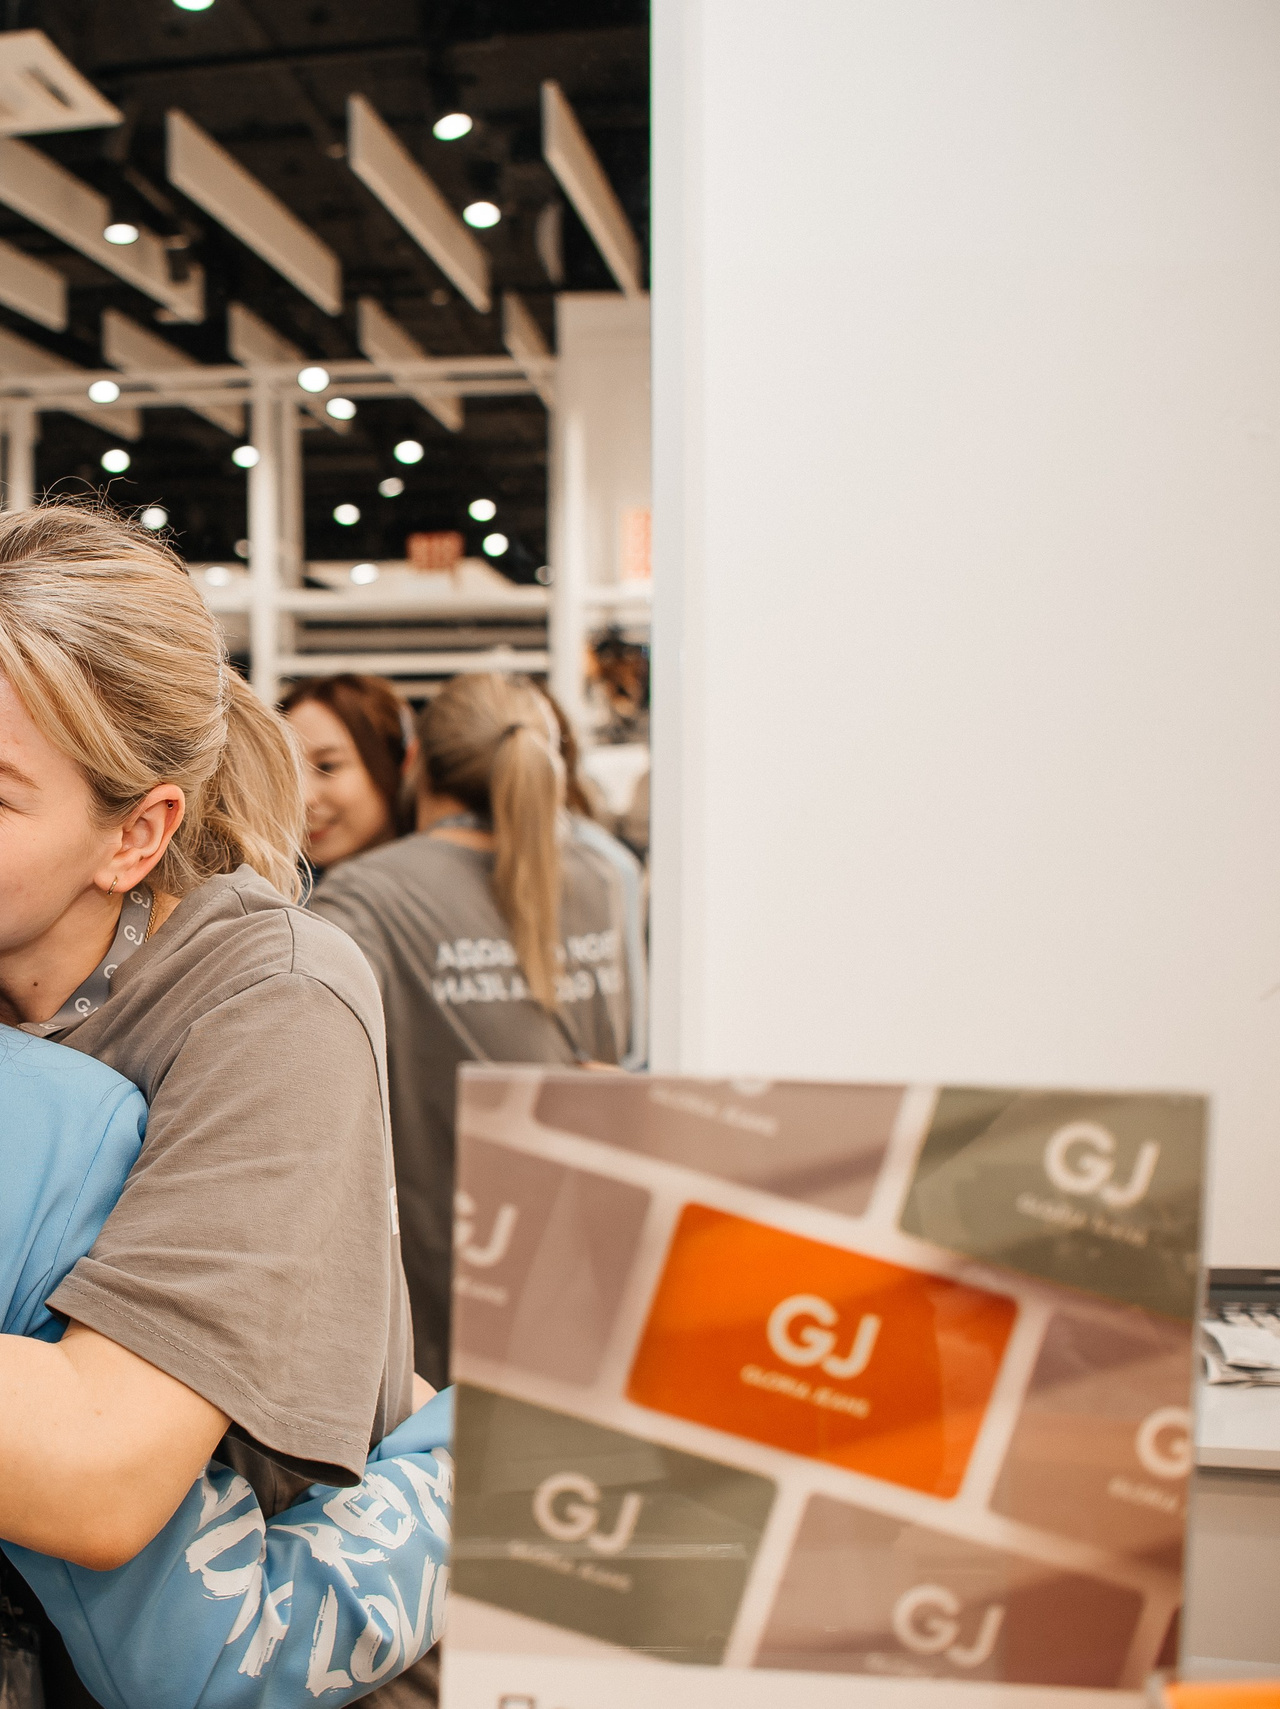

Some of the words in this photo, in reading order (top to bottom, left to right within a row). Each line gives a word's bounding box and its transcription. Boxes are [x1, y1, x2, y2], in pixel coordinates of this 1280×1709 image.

[124, 925, 144, 946] GJ
[130, 891, 150, 909] GJ
[74, 997, 99, 1018] GJ
[1043, 1120, 1161, 1209] GJ
[766, 1292, 882, 1380] GJ
[531, 1471, 644, 1556] GJ
[891, 1582, 1006, 1669] GJ
